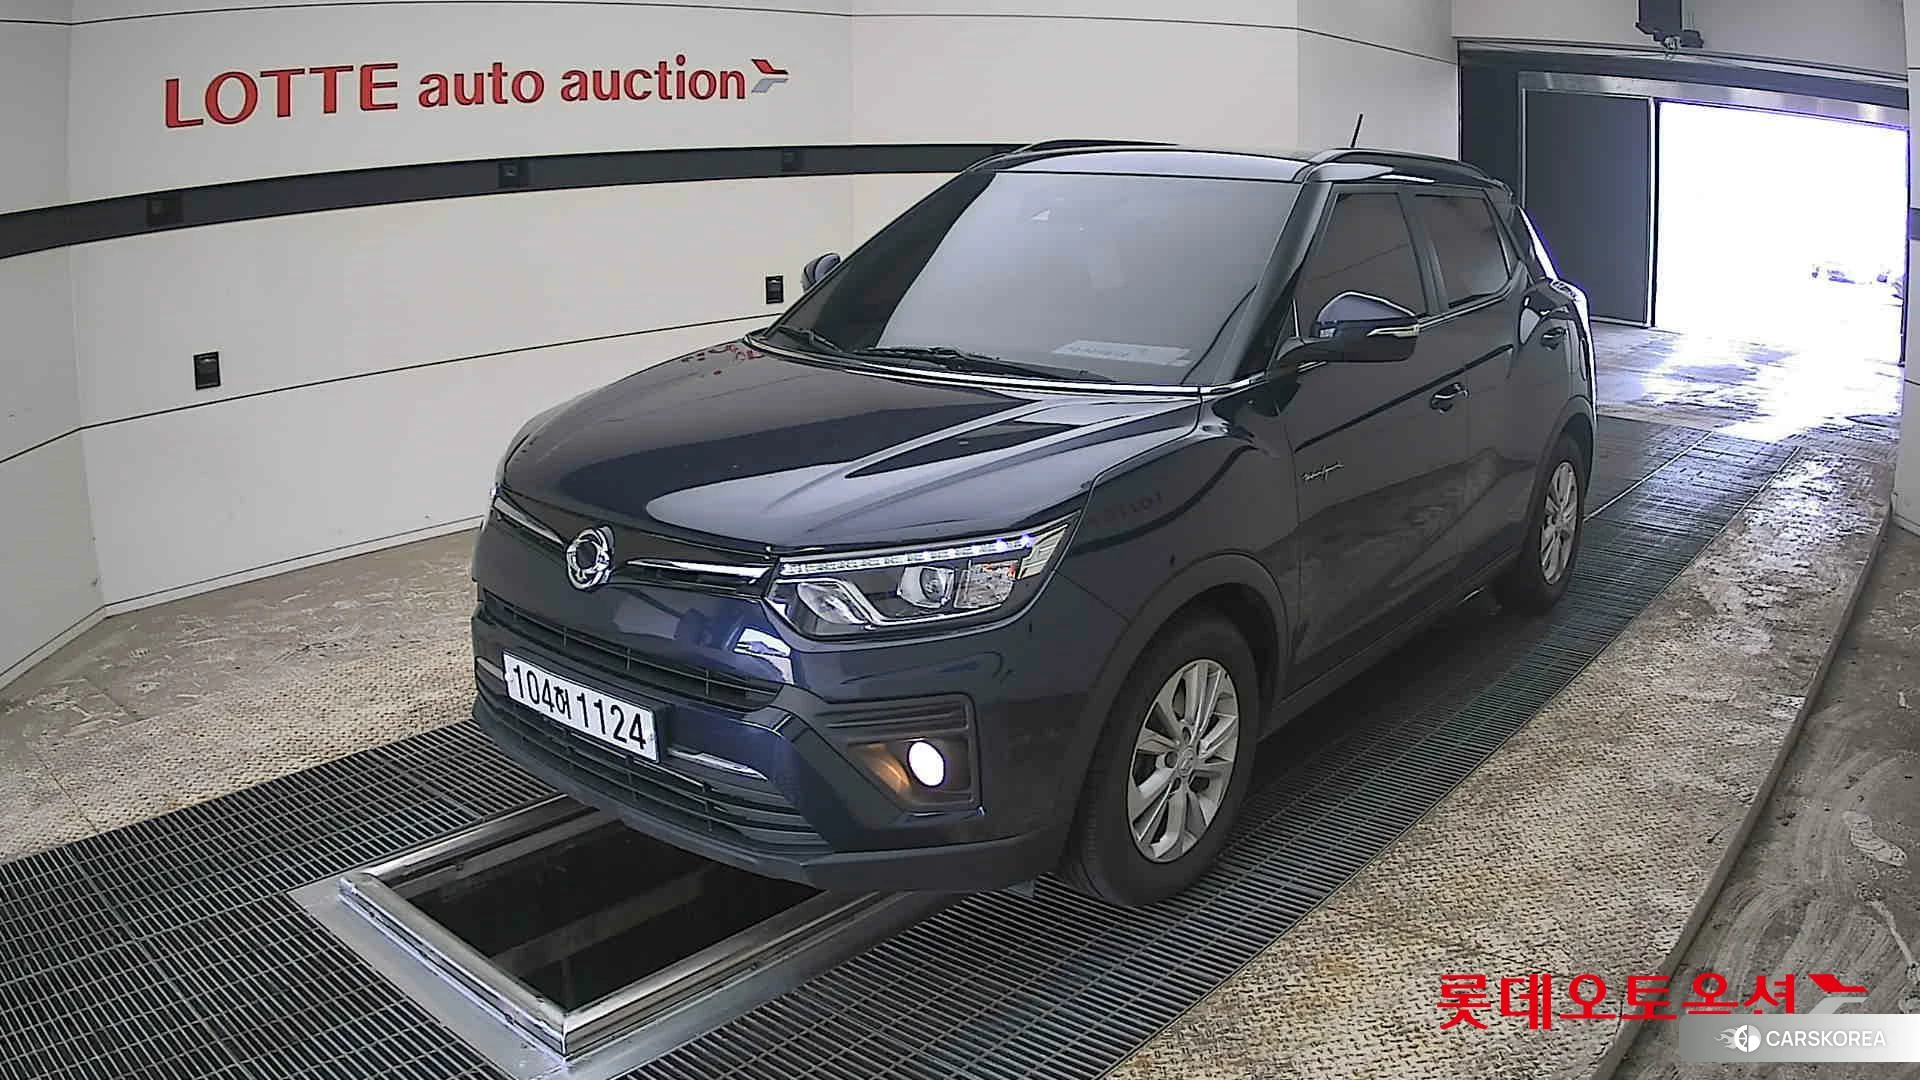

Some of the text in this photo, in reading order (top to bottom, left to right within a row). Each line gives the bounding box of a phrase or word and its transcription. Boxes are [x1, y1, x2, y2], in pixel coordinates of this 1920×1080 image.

[163, 54, 748, 129] LOTTE auto auction
[513, 664, 647, 750] 104허 1124
